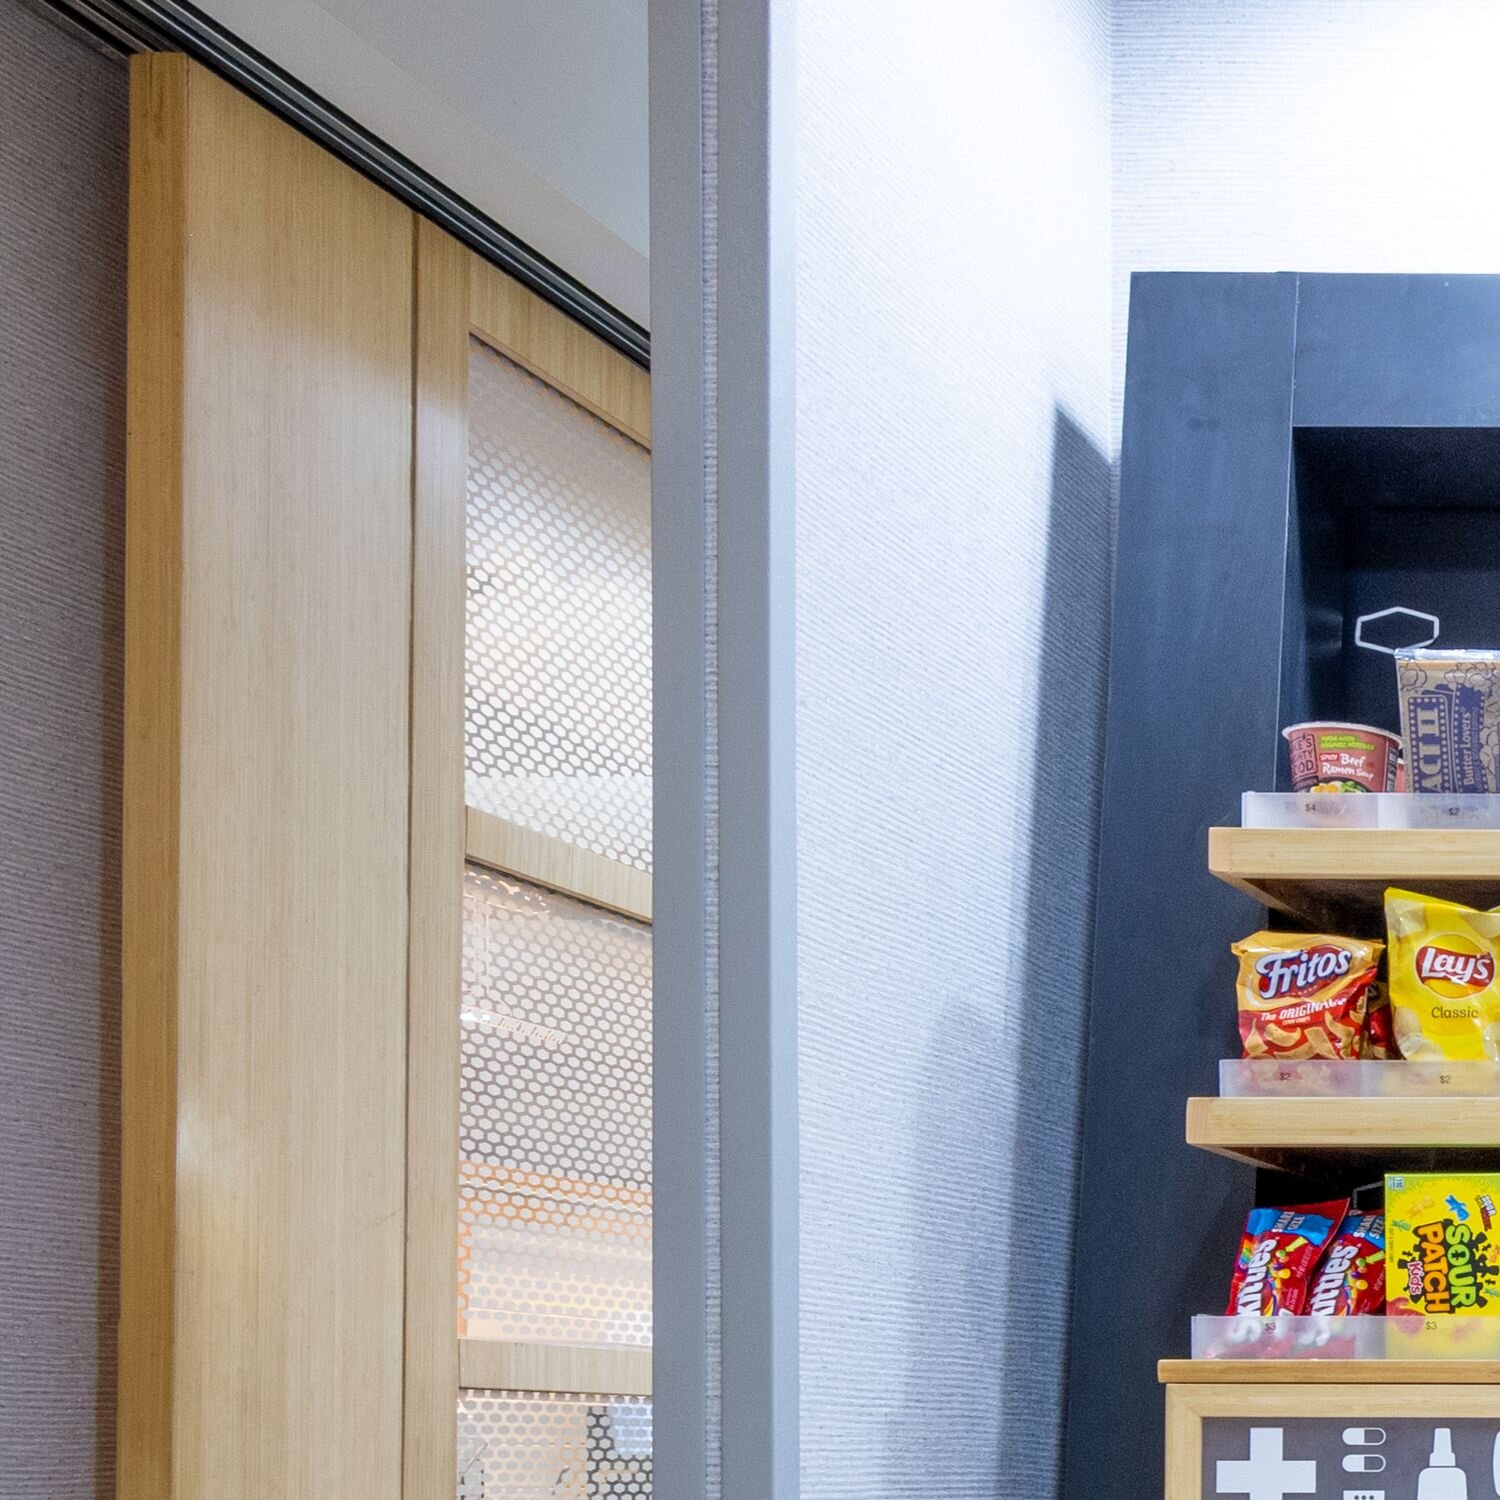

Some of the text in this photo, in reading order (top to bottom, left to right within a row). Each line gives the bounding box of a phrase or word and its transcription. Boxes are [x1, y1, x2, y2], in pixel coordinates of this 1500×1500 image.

[1460, 712, 1476, 785] Butter Lovers
[1340, 753, 1366, 767] Beef
[1322, 762, 1374, 782] Ramen Soup
[1304, 803, 1316, 812] $4
[1448, 808, 1460, 816] $2
[1421, 946, 1491, 986] Lay's
[1255, 950, 1352, 1000] Fritos
[1431, 1006, 1479, 1019] Classic
[1280, 1072, 1291, 1081] $2
[1440, 1074, 1450, 1084] $2
[1417, 1220, 1450, 1313] PATCH
[1445, 1223, 1477, 1307] SOUR
[1407, 1260, 1424, 1295] Kids
[1425, 1322, 1437, 1330] $3
